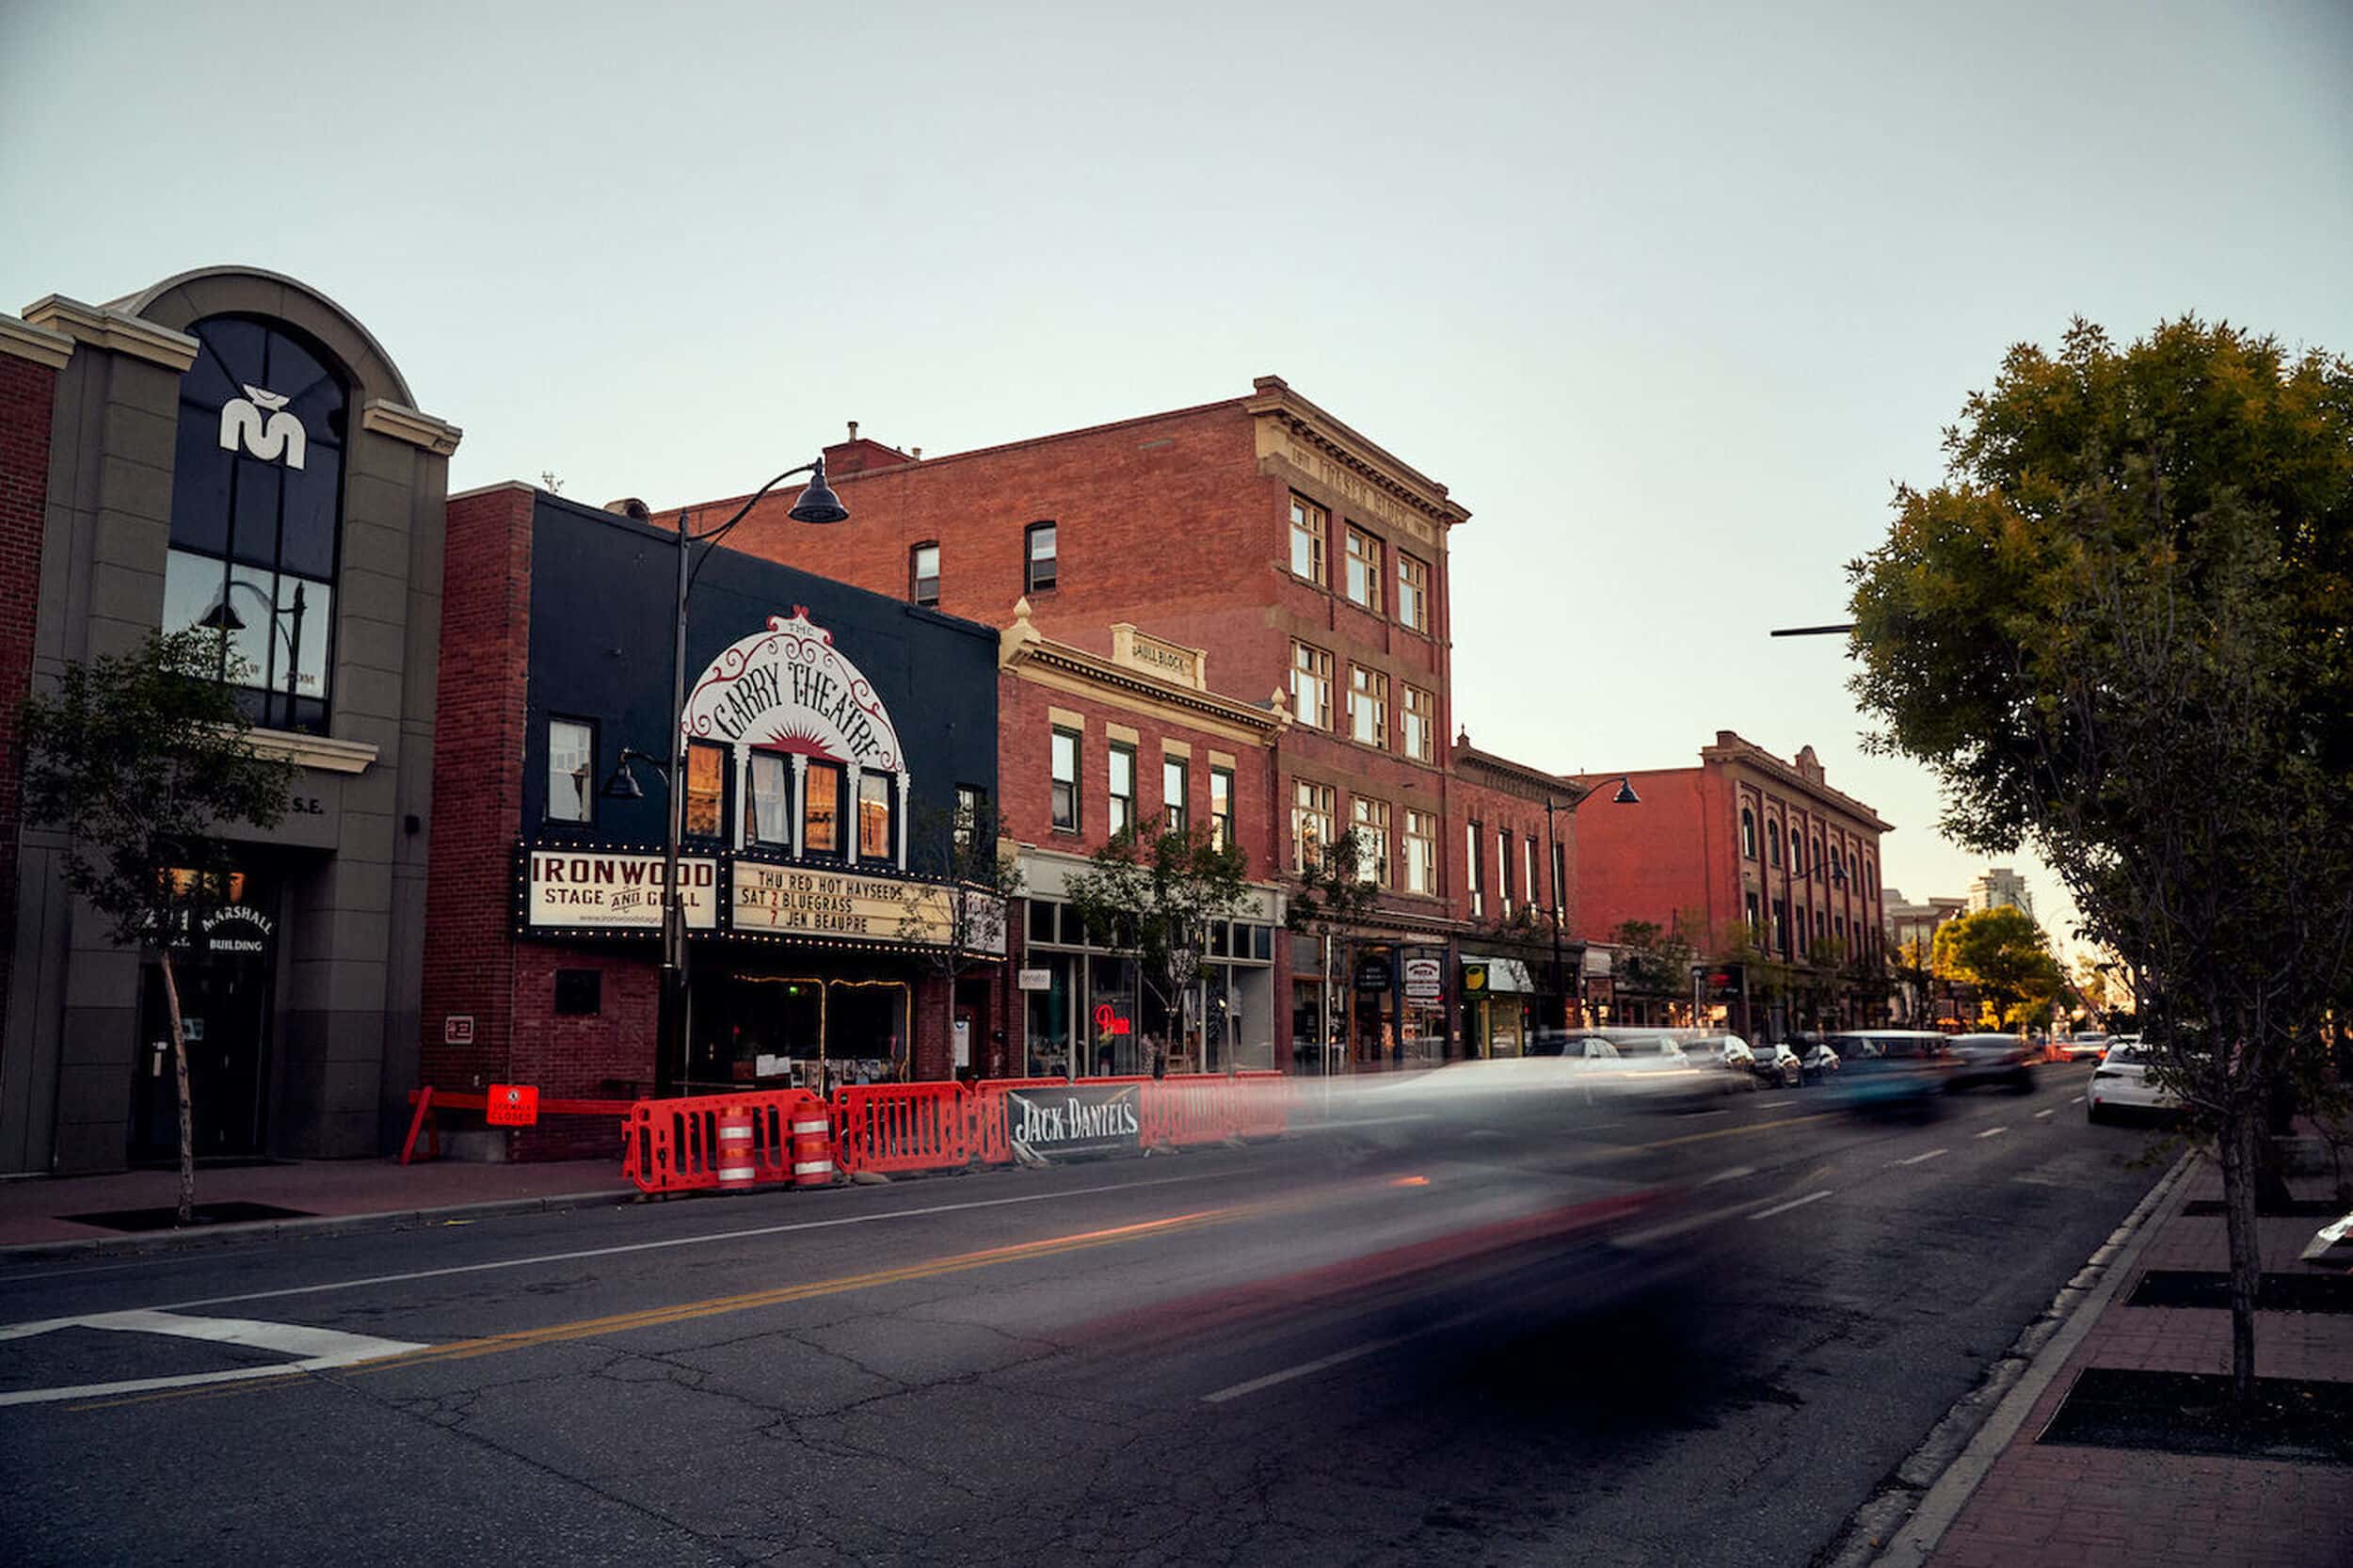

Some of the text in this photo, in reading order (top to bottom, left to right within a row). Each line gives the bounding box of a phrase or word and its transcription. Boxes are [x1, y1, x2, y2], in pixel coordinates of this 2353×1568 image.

[788, 622, 815, 637] THE
[712, 662, 881, 765] GARRY THEATRE
[292, 797, 324, 815] S.E.
[532, 857, 712, 888] IRONWOOD
[545, 888, 604, 904] STAGE
[612, 892, 640, 907] AND
[758, 871, 904, 901] THU RED HOT HAYSEEDS
[742, 888, 853, 913] SAT 2 BLUEGRASS
[200, 905, 275, 936] MARSHALL
[770, 909, 778, 925] 7
[814, 914, 868, 934] BEAUPRE
[209, 938, 264, 952] BUILDING
[1015, 1098, 1064, 1144] JACK
